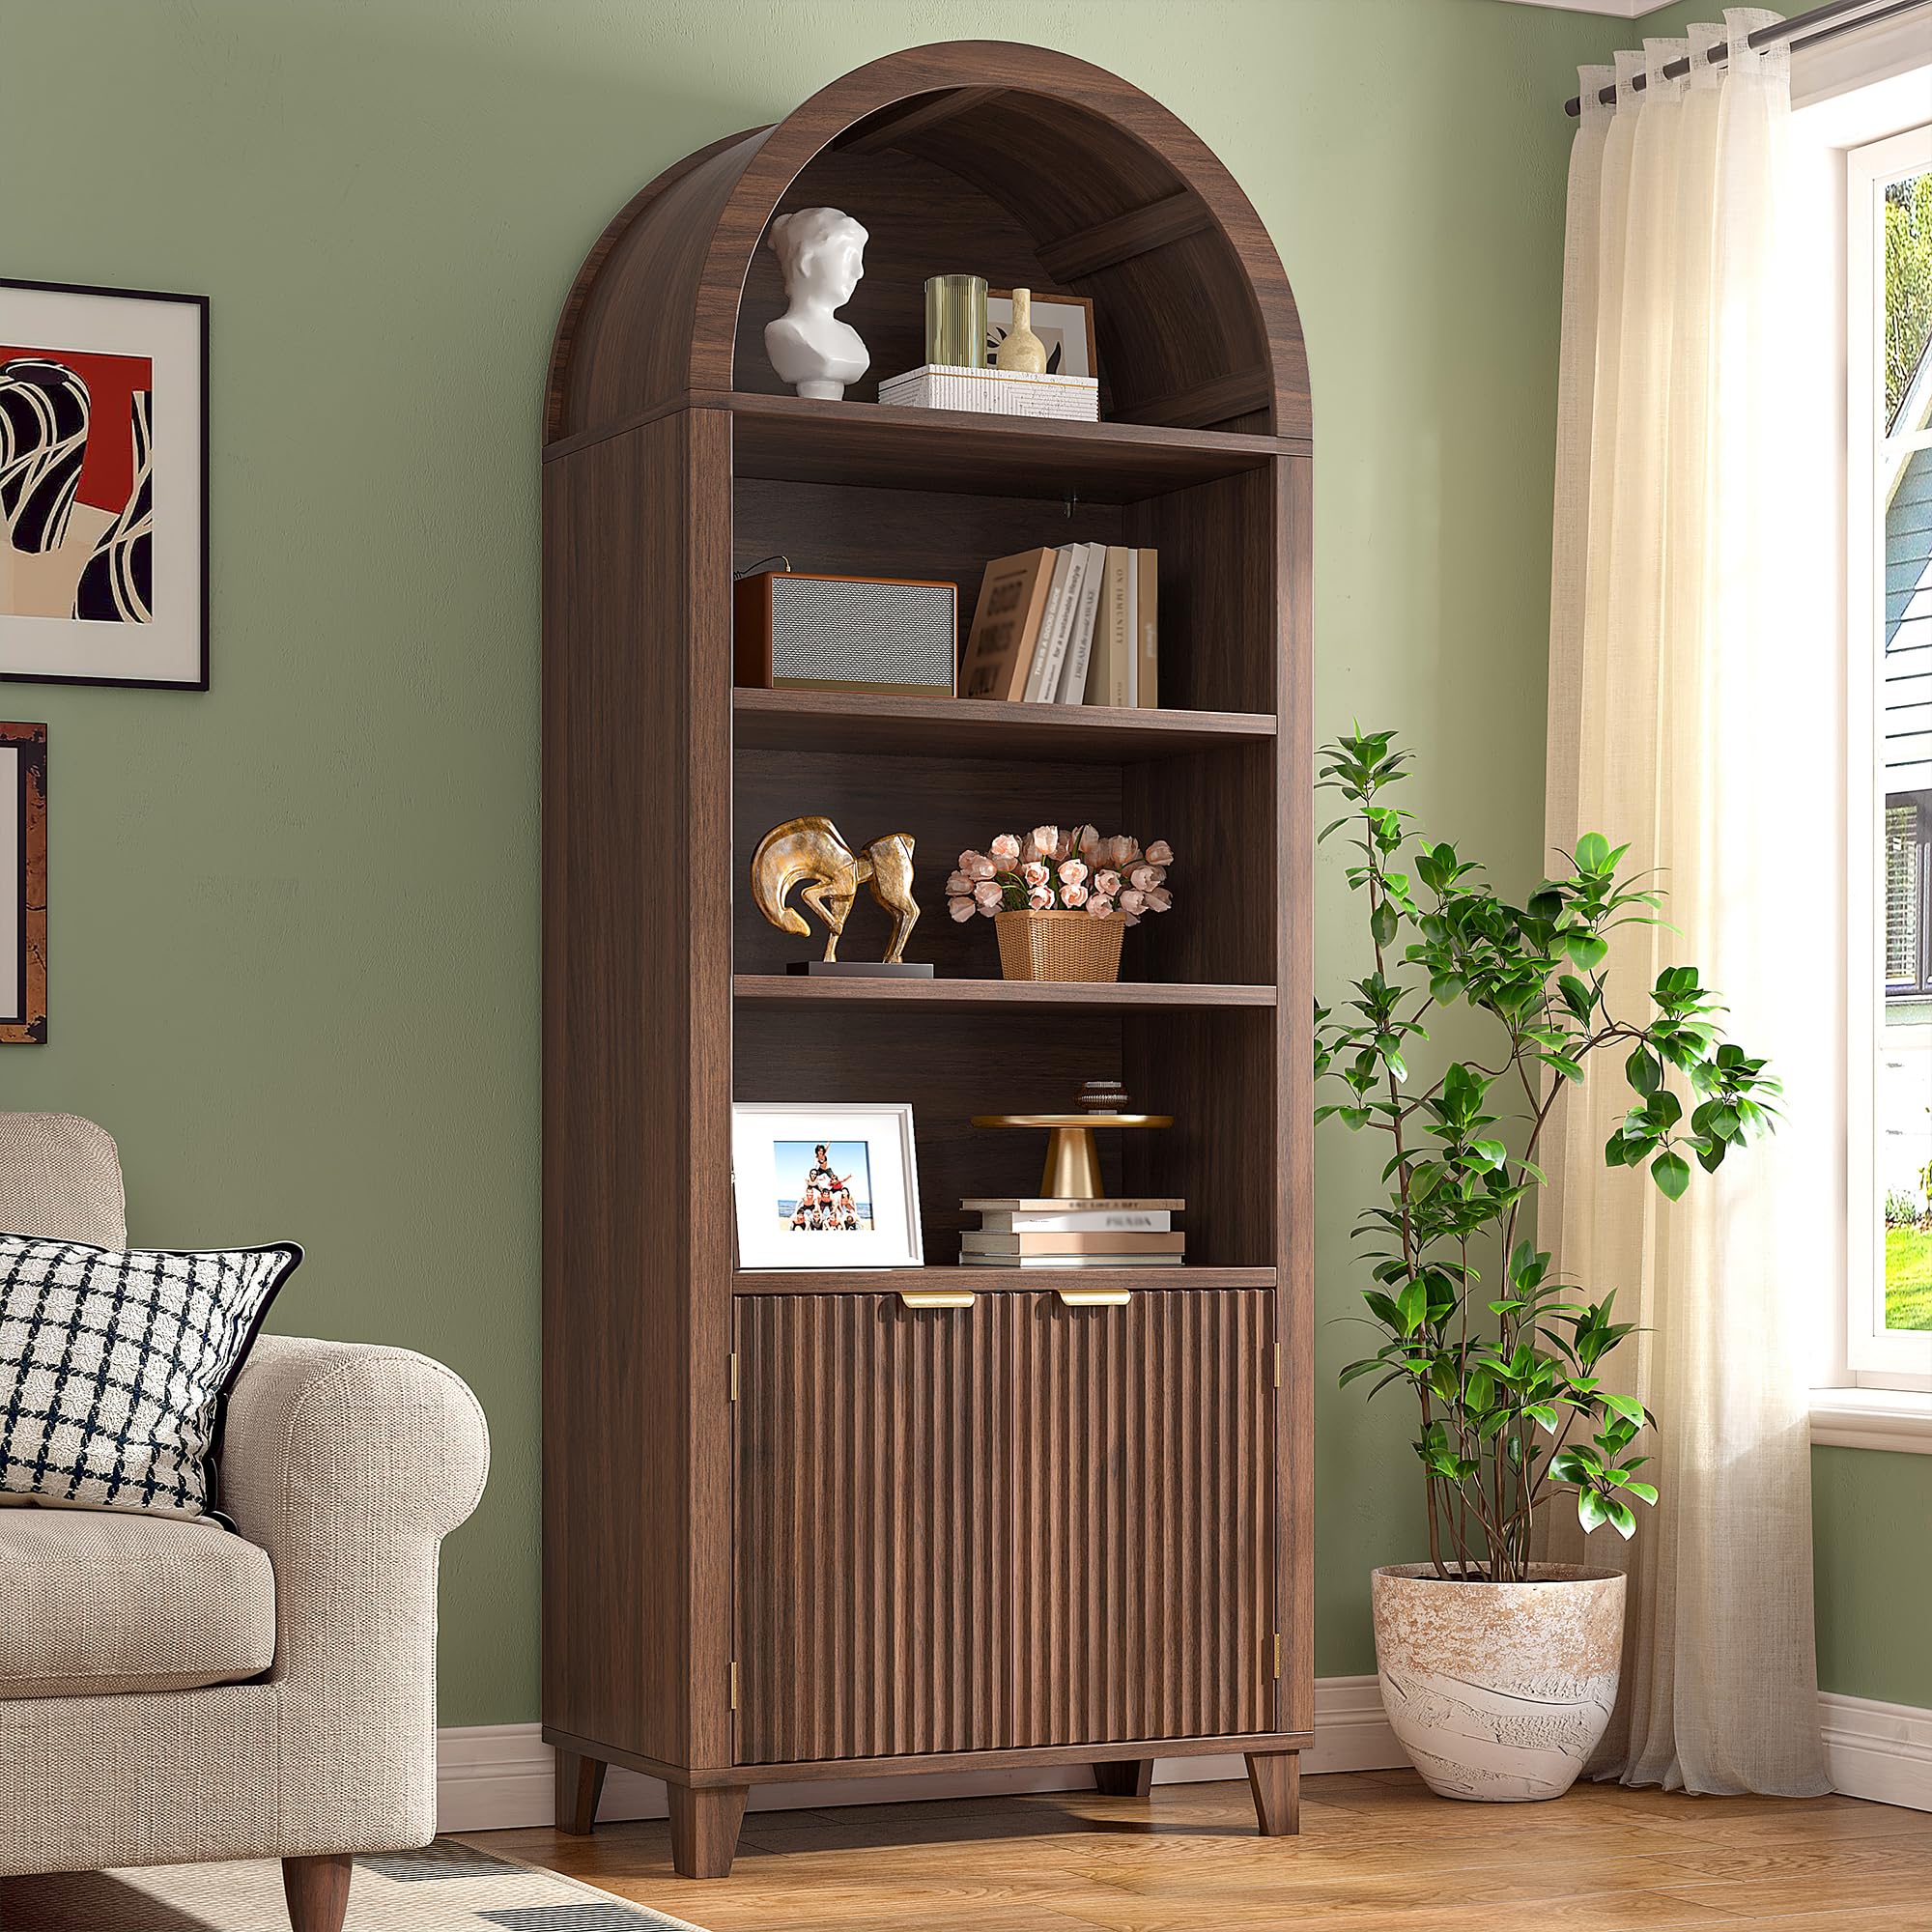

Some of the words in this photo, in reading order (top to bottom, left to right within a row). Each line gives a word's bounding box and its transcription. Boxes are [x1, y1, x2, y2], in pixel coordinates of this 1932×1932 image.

[1059, 596, 1072, 639] sustainable
[1068, 565, 1081, 595] lifestyle
[1116, 569, 1122, 582] ON
[1035, 657, 1044, 675] THIS
[1043, 613, 1054, 639] GOOD
[1049, 586, 1061, 613] GUIDE
